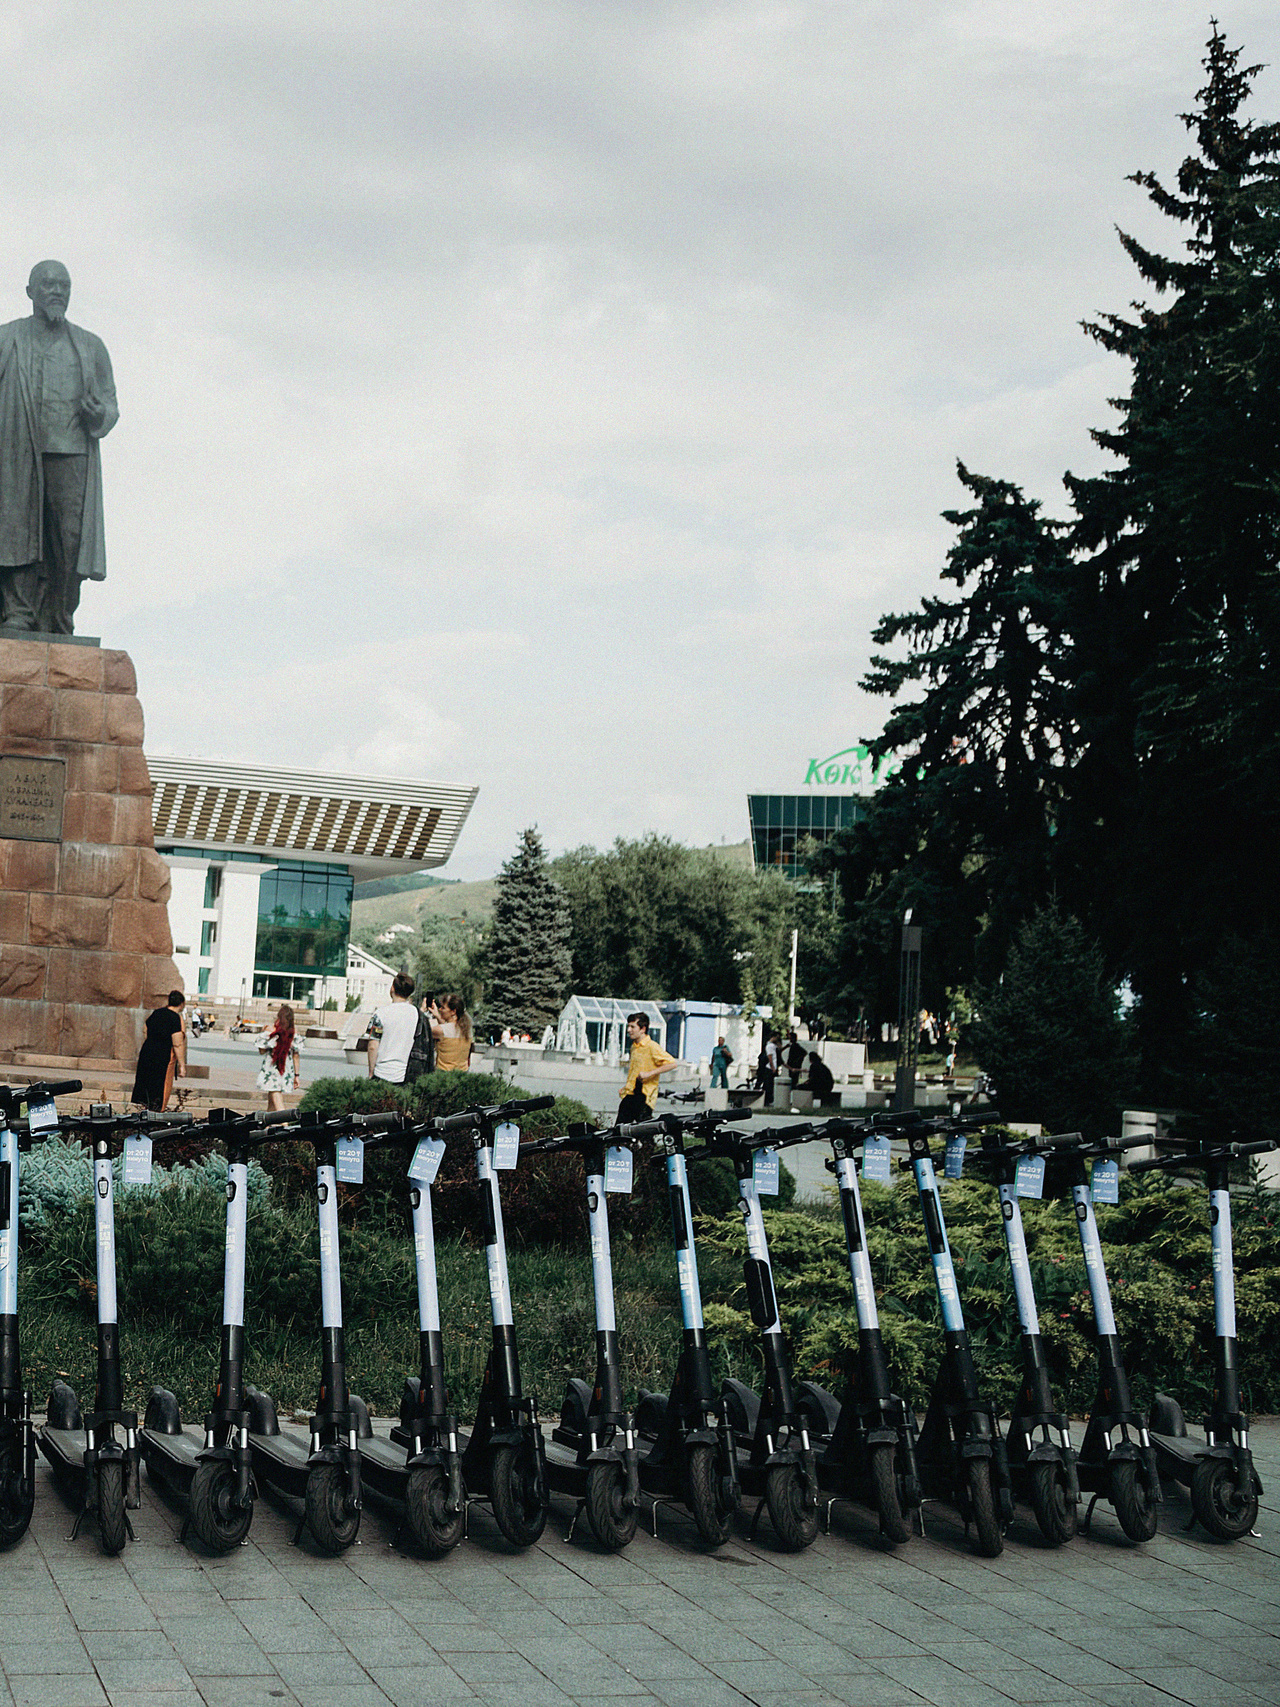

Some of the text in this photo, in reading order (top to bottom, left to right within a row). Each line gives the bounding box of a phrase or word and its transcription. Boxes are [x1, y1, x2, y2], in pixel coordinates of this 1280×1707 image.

[803, 752, 865, 784] Көк
[99, 1221, 111, 1251] JET
[225, 1225, 235, 1254] JET
[320, 1228, 331, 1256] JET
[414, 1232, 426, 1261] JET
[591, 1235, 603, 1262] JET
[745, 1221, 761, 1259] JET
[1008, 1241, 1021, 1268] JET
[1083, 1243, 1097, 1269] JET
[1212, 1247, 1221, 1272] JET
[489, 1268, 502, 1304] JET
[678, 1261, 691, 1296] JET
[855, 1277, 869, 1304] JET
[936, 1266, 955, 1300] JET
